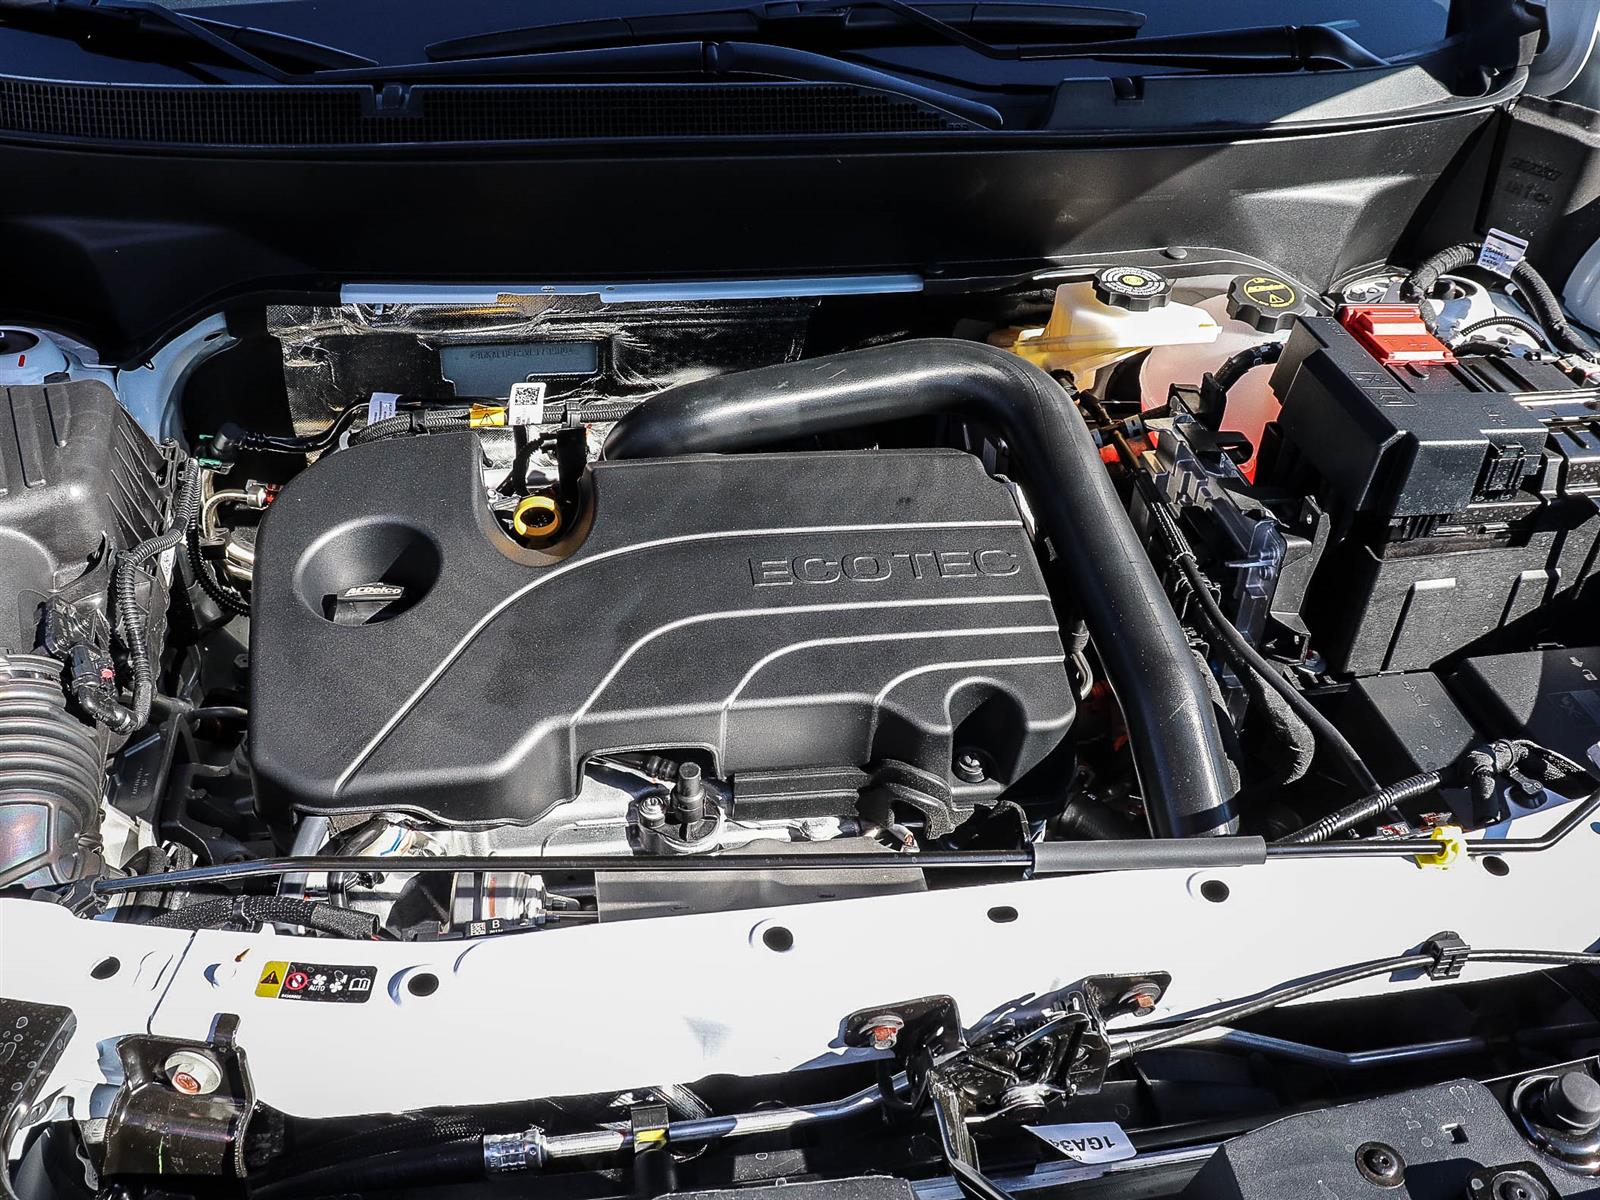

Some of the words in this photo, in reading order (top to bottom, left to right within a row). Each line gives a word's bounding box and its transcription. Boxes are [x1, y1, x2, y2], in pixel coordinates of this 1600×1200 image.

[749, 549, 1020, 588] ECOTEC
[344, 586, 402, 597] ACDelco
[492, 919, 500, 929] B
[308, 984, 326, 992] AUTO
